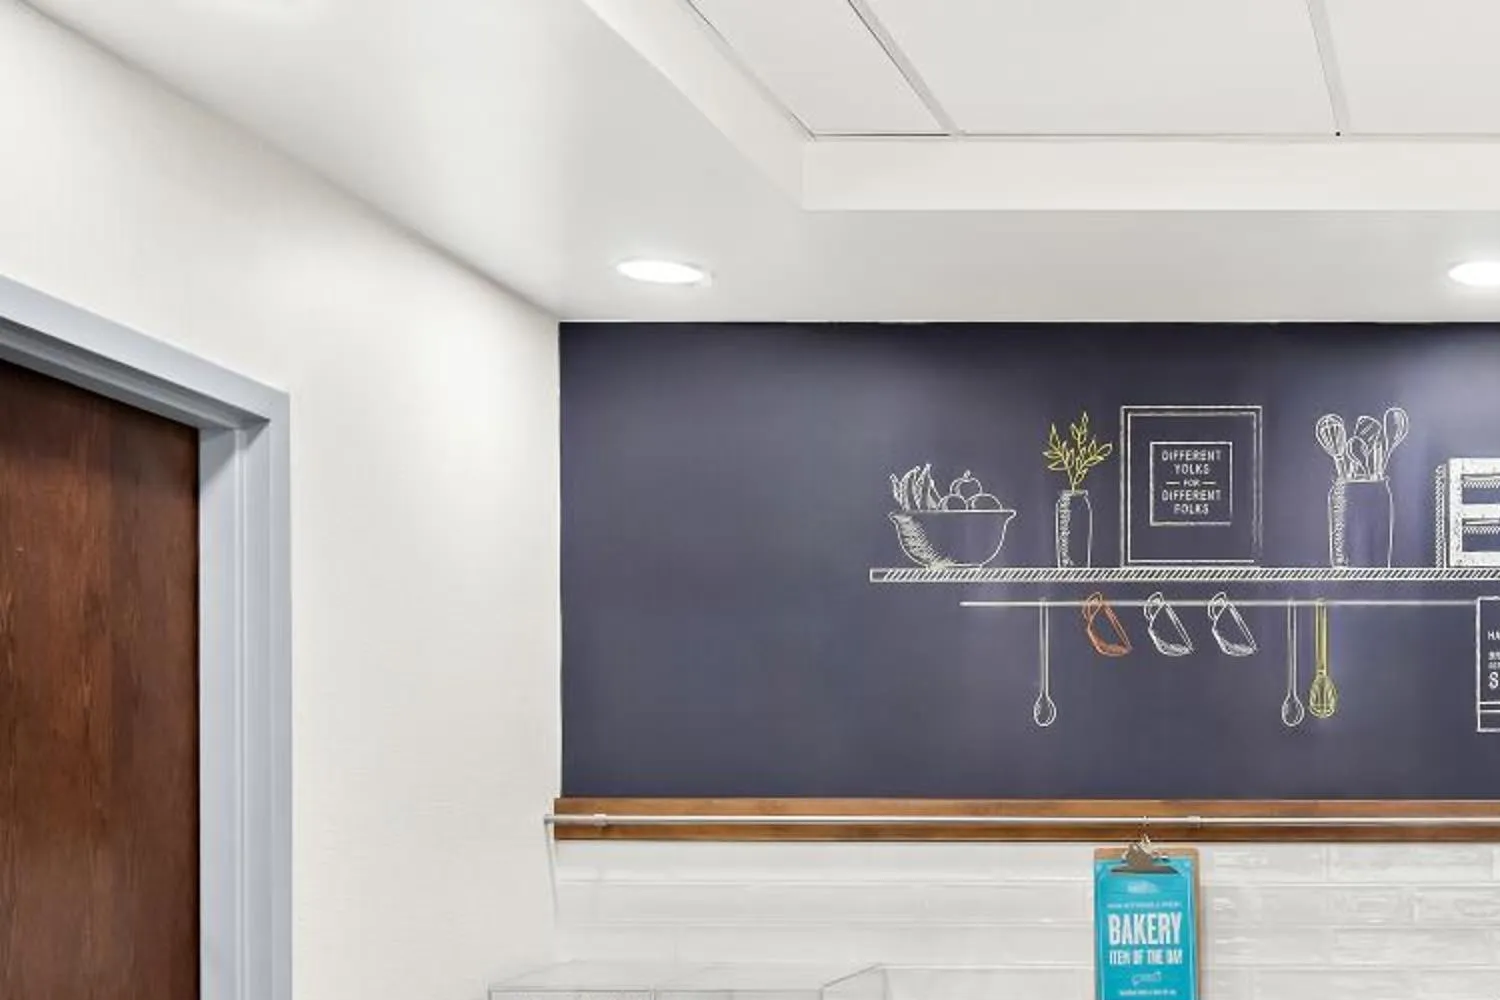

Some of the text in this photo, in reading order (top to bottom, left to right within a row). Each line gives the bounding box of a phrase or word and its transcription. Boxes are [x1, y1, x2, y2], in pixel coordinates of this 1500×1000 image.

[1161, 449, 1222, 461] DIFFERENT
[1174, 463, 1210, 475] YOLKS
[1161, 489, 1222, 501] DIFFERENT
[1174, 503, 1210, 515] FOLKS
[1107, 912, 1183, 945] BAKERY
